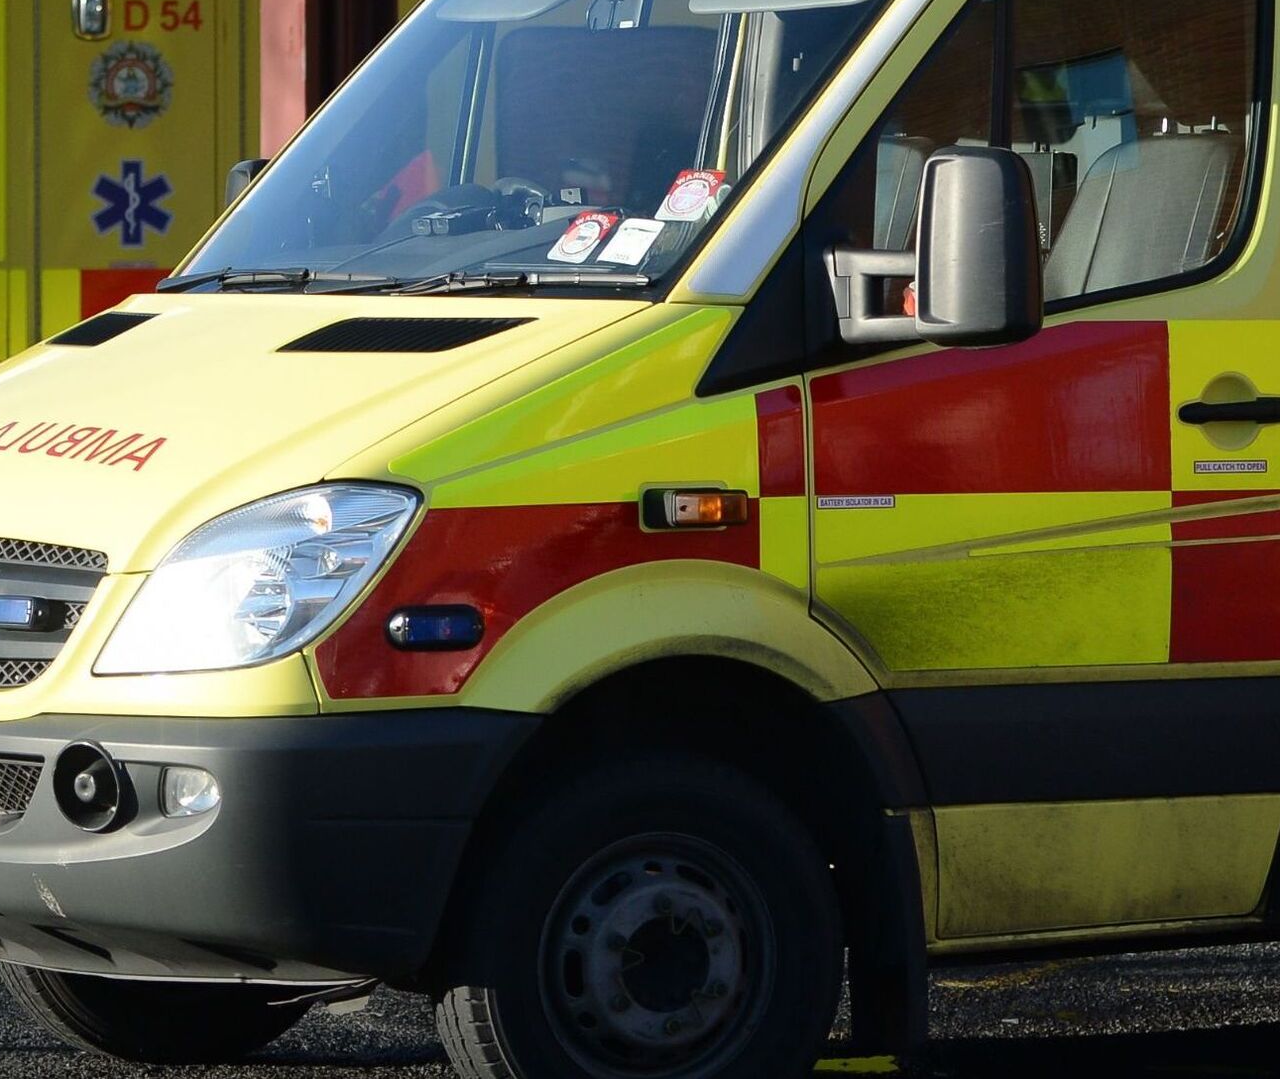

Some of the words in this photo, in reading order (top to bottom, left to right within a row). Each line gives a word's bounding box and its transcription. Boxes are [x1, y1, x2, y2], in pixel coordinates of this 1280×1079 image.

[123, 0, 150, 32] D
[159, 0, 203, 32] 54
[675, 171, 719, 187] WARNING
[575, 213, 611, 230] WARNING
[1196, 463, 1211, 471] PULL
[1212, 463, 1235, 471] CATCH
[1247, 462, 1265, 470] OPEN
[820, 499, 844, 507] BATTERY
[845, 498, 871, 506] ISOLATOR
[881, 498, 893, 506] CAB
